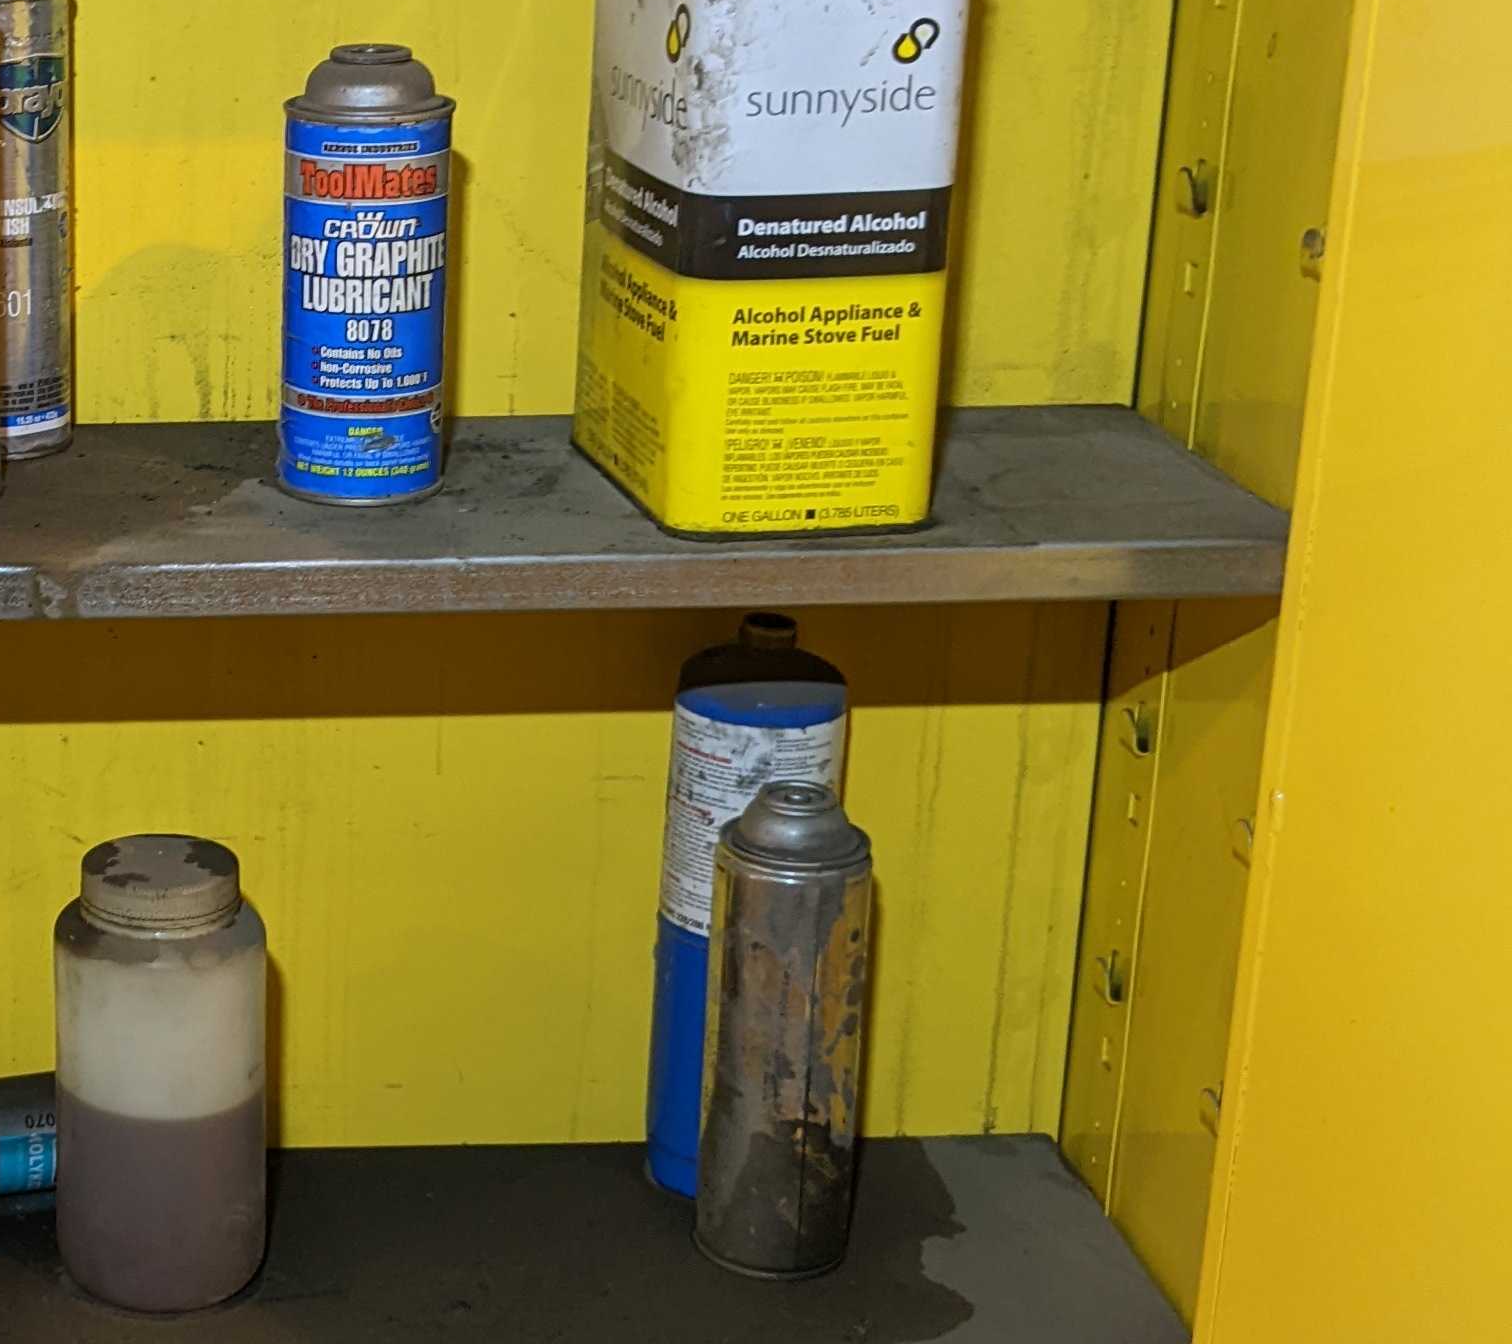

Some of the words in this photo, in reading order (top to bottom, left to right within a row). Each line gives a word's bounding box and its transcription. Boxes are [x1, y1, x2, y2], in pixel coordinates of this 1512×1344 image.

[609, 62, 689, 132] sunnyside
[745, 74, 937, 128] sunnyside
[300, 159, 438, 200] ToolMates
[736, 213, 847, 237] Denatured
[850, 211, 927, 233] Alcohol
[290, 234, 328, 277] DRY
[336, 231, 445, 278] GRAPHITE
[736, 242, 795, 260] Alcohol
[796, 239, 916, 258] Desnaturalizado
[302, 272, 433, 315] LUBRICANT
[731, 306, 805, 326] Alcohol
[808, 303, 904, 326] Appliance
[907, 301, 922, 318] &
[346, 319, 393, 342] 8078
[646, 312, 667, 342] Fuel
[731, 329, 799, 347] Marine
[803, 327, 857, 345] Stove
[860, 324, 901, 343] Fuel
[320, 346, 365, 360] Contains
[367, 348, 381, 360] No
[383, 347, 403, 359] Oils
[320, 361, 393, 375] Non-Corrosive
[320, 375, 363, 390] Protects
[365, 378, 379, 390] Up
[382, 378, 393, 389] To
[722, 511, 752, 523] ONE
[752, 509, 802, 522] GALLON
[854, 504, 900, 518] LITERS)
